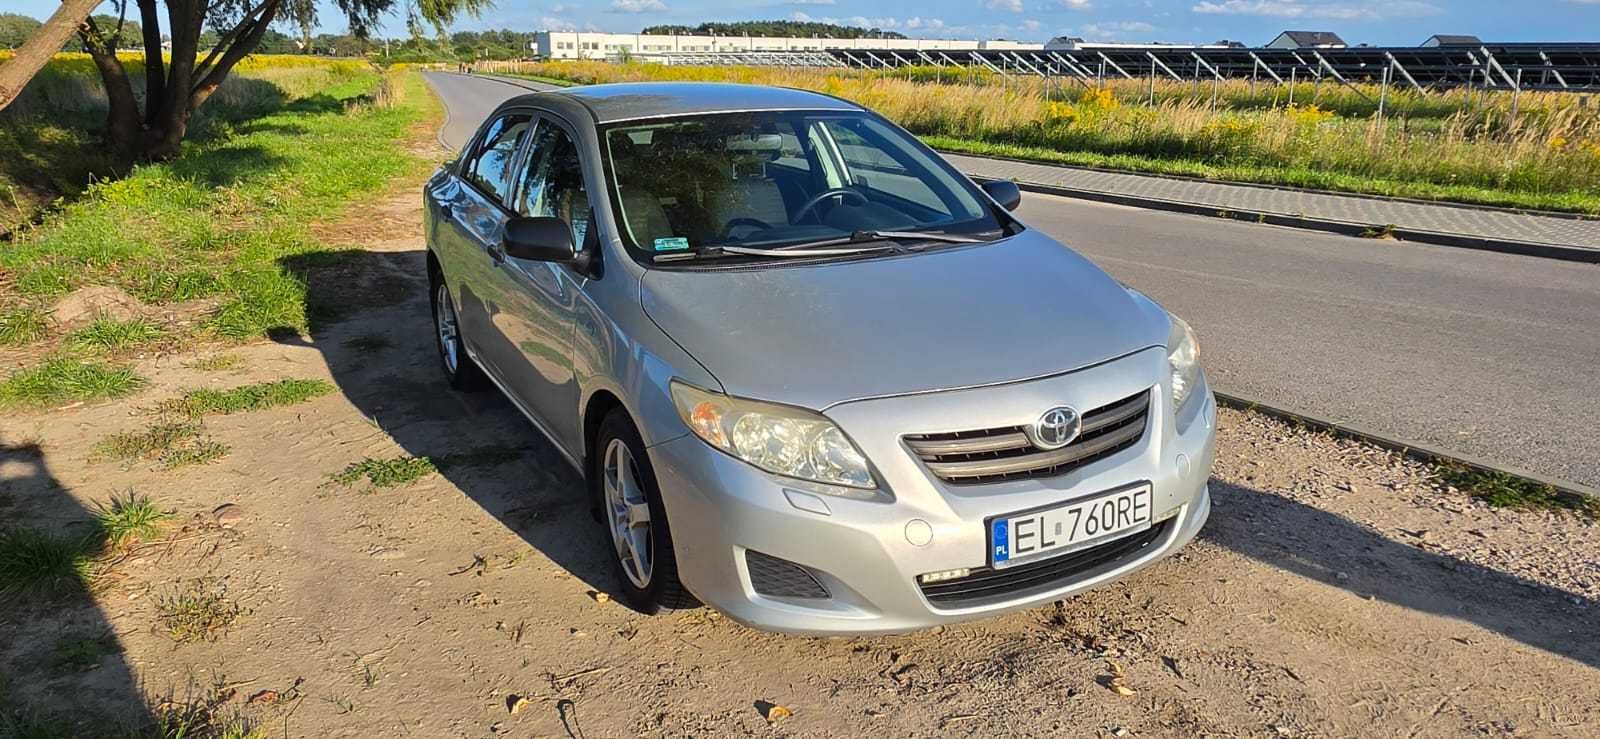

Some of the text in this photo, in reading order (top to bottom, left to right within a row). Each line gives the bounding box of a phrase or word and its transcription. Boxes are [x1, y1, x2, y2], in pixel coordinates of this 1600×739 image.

[1014, 490, 1147, 554] EL 760RE
[996, 546, 1007, 556] PL
